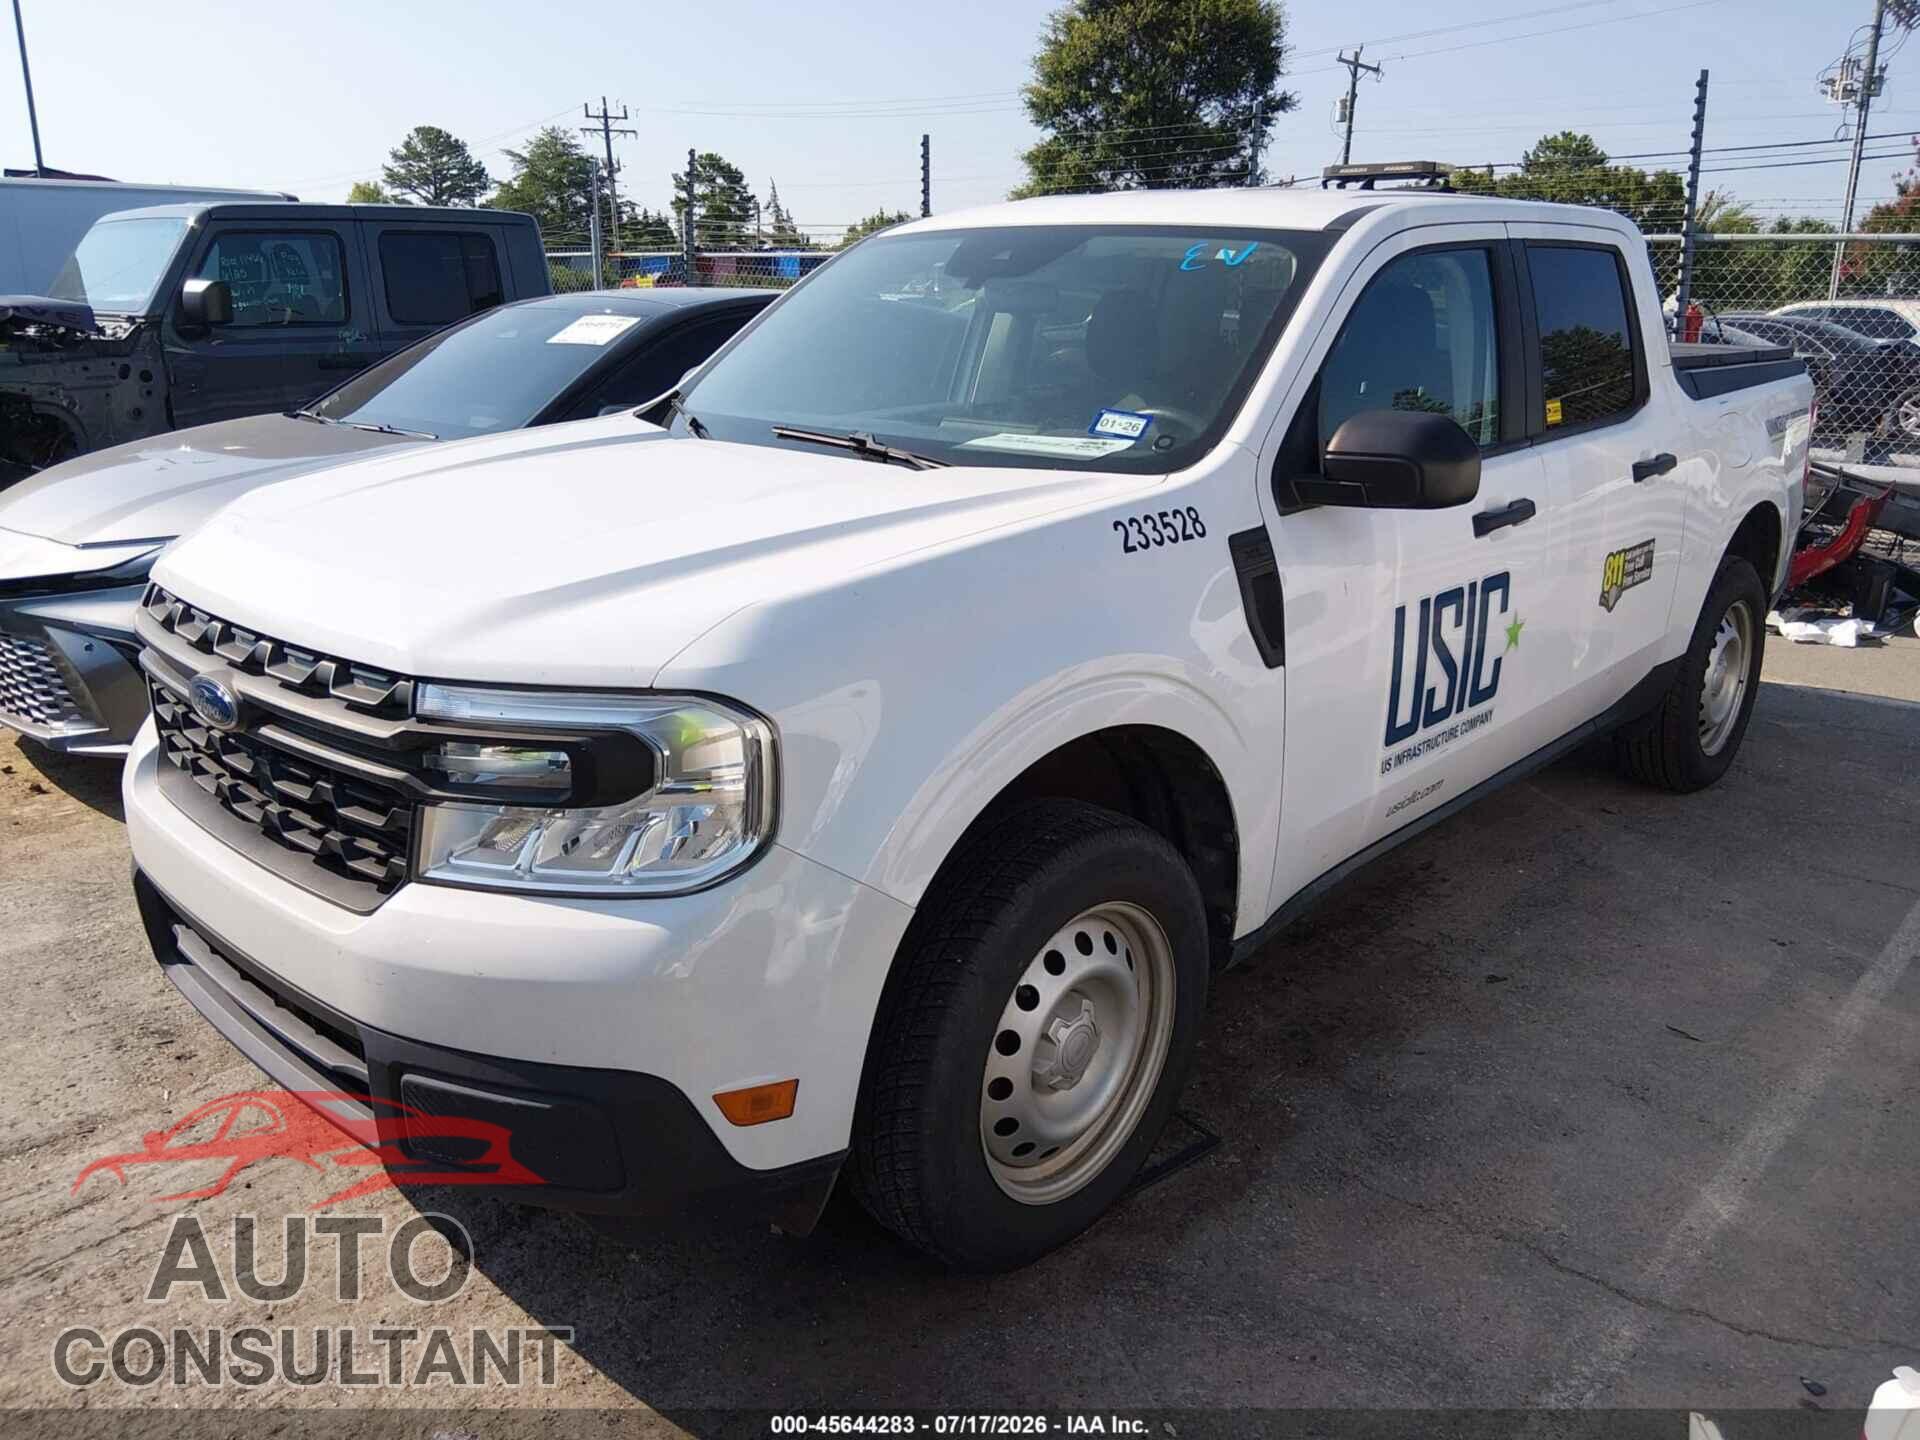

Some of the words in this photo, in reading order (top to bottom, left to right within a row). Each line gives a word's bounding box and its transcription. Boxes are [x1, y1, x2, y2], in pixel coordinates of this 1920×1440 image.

[1113, 506, 1207, 554] 233528
[1384, 571, 1510, 748] USIC
[1380, 757, 1393, 775] US
[1394, 727, 1460, 768] INFRASTRUCTURE
[1460, 709, 1494, 735] COMPANY
